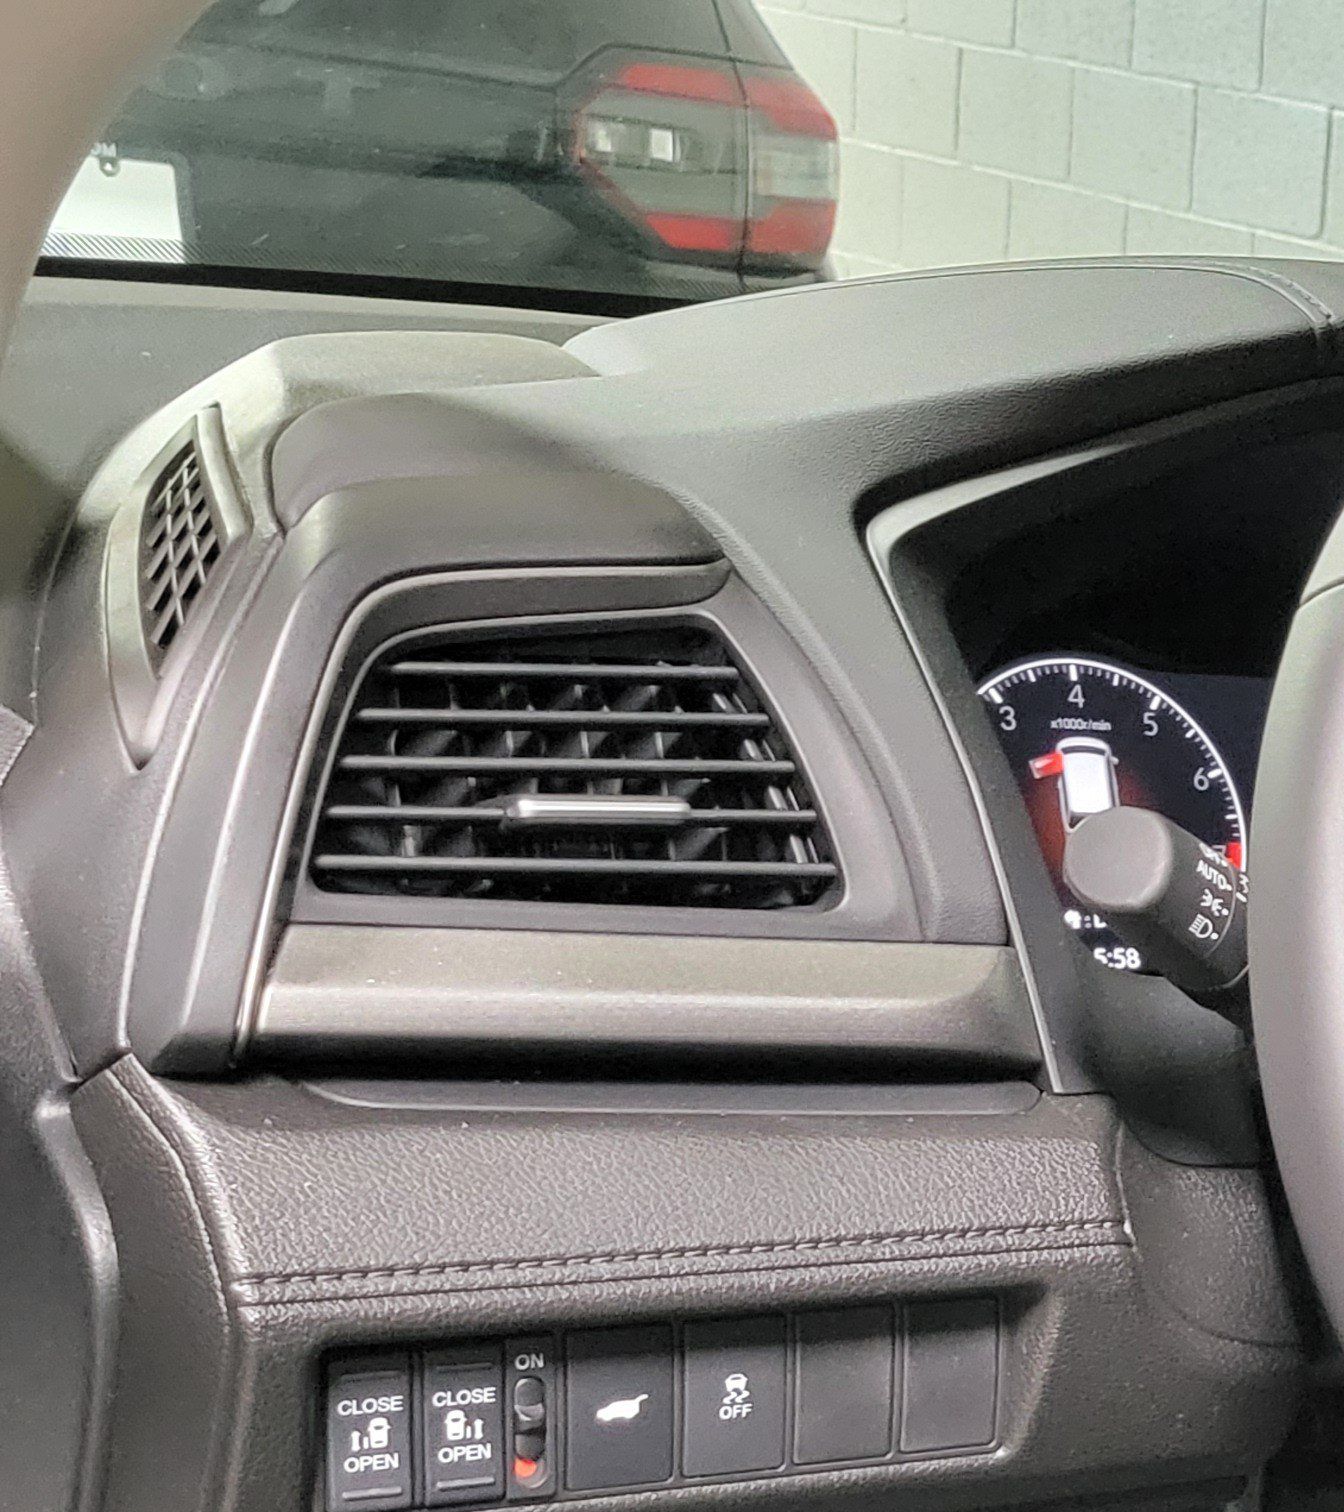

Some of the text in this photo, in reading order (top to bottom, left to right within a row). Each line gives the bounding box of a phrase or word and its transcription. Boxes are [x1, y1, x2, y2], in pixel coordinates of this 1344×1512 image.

[1068, 684, 1085, 709] 4
[999, 706, 1017, 731] 3
[1143, 712, 1159, 737] 5
[1193, 767, 1210, 791] 6
[1196, 860, 1228, 890] AUTO
[1094, 947, 1142, 970] 5:58
[514, 1353, 545, 1370] ON
[337, 1396, 404, 1416] CLOSE
[432, 1387, 496, 1407] CLOSE
[719, 1403, 753, 1420] OFF
[344, 1453, 399, 1473] OPEN
[438, 1443, 492, 1463] OPEN
